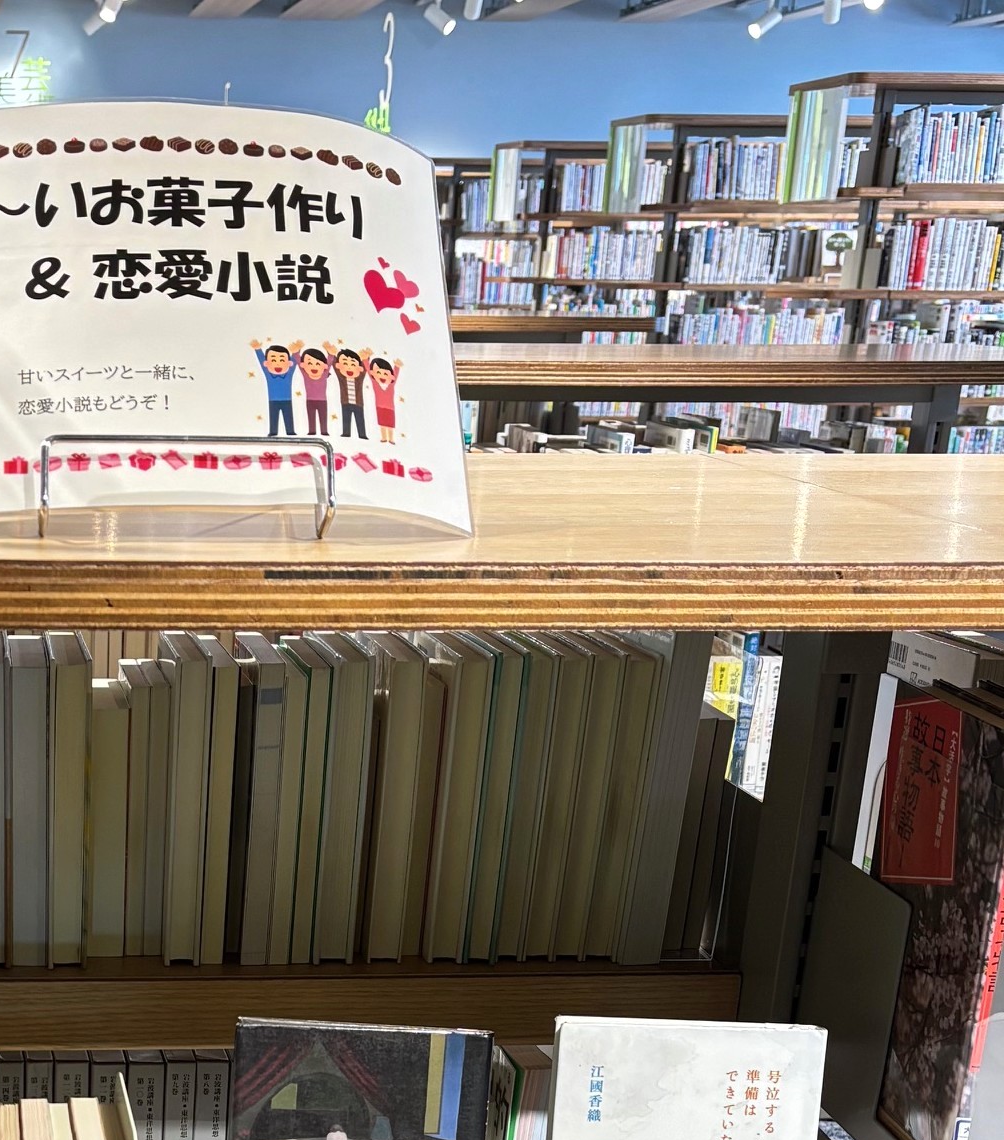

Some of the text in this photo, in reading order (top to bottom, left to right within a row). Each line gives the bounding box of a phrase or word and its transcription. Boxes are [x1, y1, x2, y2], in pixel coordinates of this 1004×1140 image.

[26, 249, 334, 304] & 恋愛小説
[17, 364, 198, 386] 甘いスイーツと一緒に、
[17, 394, 171, 417] 恋愛小説もどうぞ！
[587, 1065, 605, 1122] 江國香織
[743, 1068, 761, 1117] 準備は
[765, 1070, 782, 1135] 号泣する
